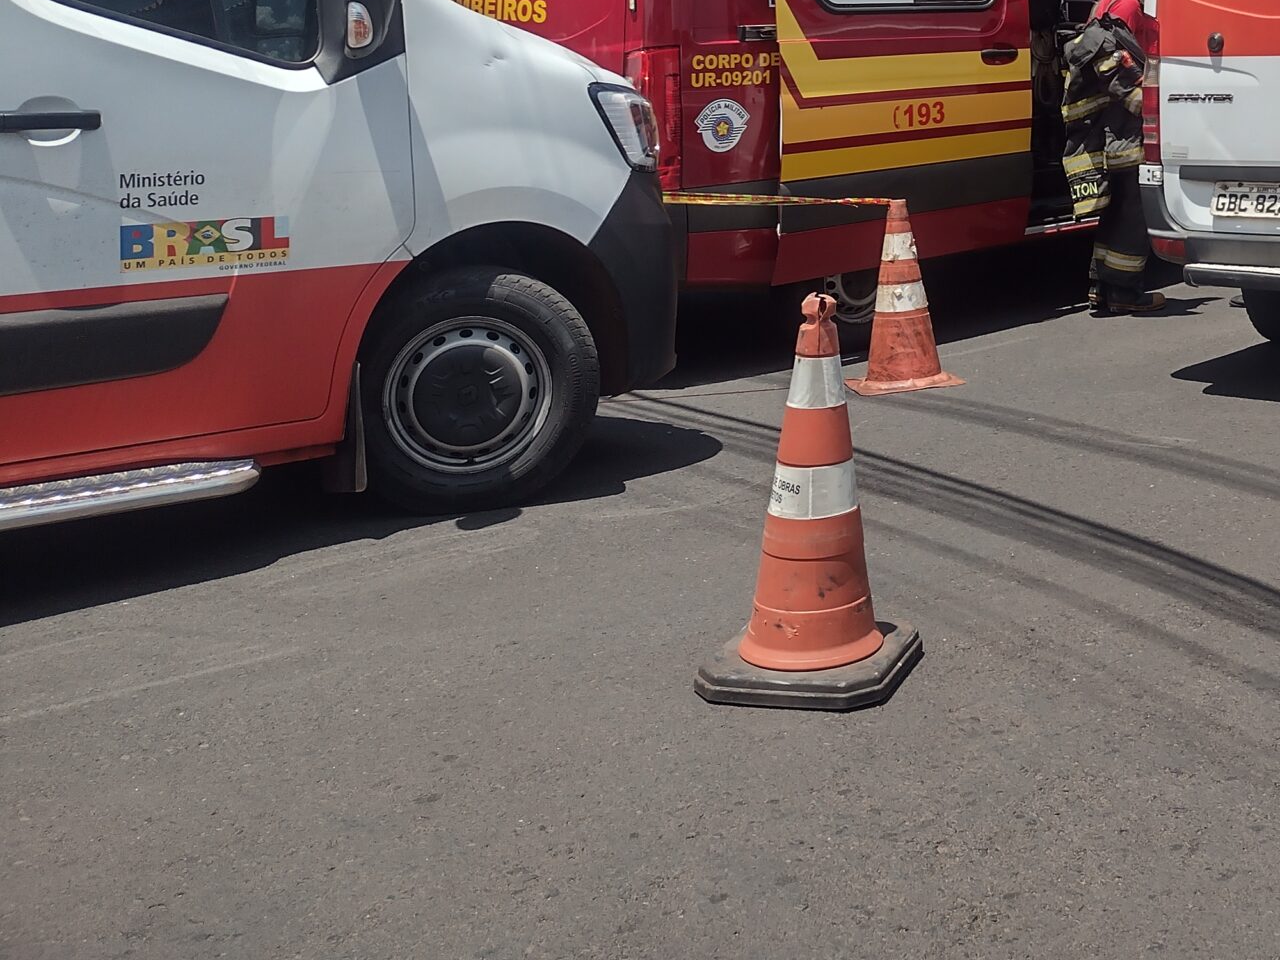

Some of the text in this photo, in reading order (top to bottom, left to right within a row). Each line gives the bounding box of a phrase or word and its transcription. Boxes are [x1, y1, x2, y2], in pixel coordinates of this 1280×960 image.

[692, 52, 780, 70] CORPO DE
[690, 69, 771, 88] UR-09201
[1167, 93, 1234, 103] SPRINTER
[723, 102, 746, 121] MILITAR
[903, 101, 946, 127] 193
[119, 170, 205, 189] Ministério
[120, 190, 199, 209] da Saúde
[120, 216, 290, 261] BRASIL
[123, 249, 288, 270] UM PAÍS DE TODOS
[219, 260, 287, 271] GOVERNO FEDERAL
[778, 479, 801, 496] OBRAS
